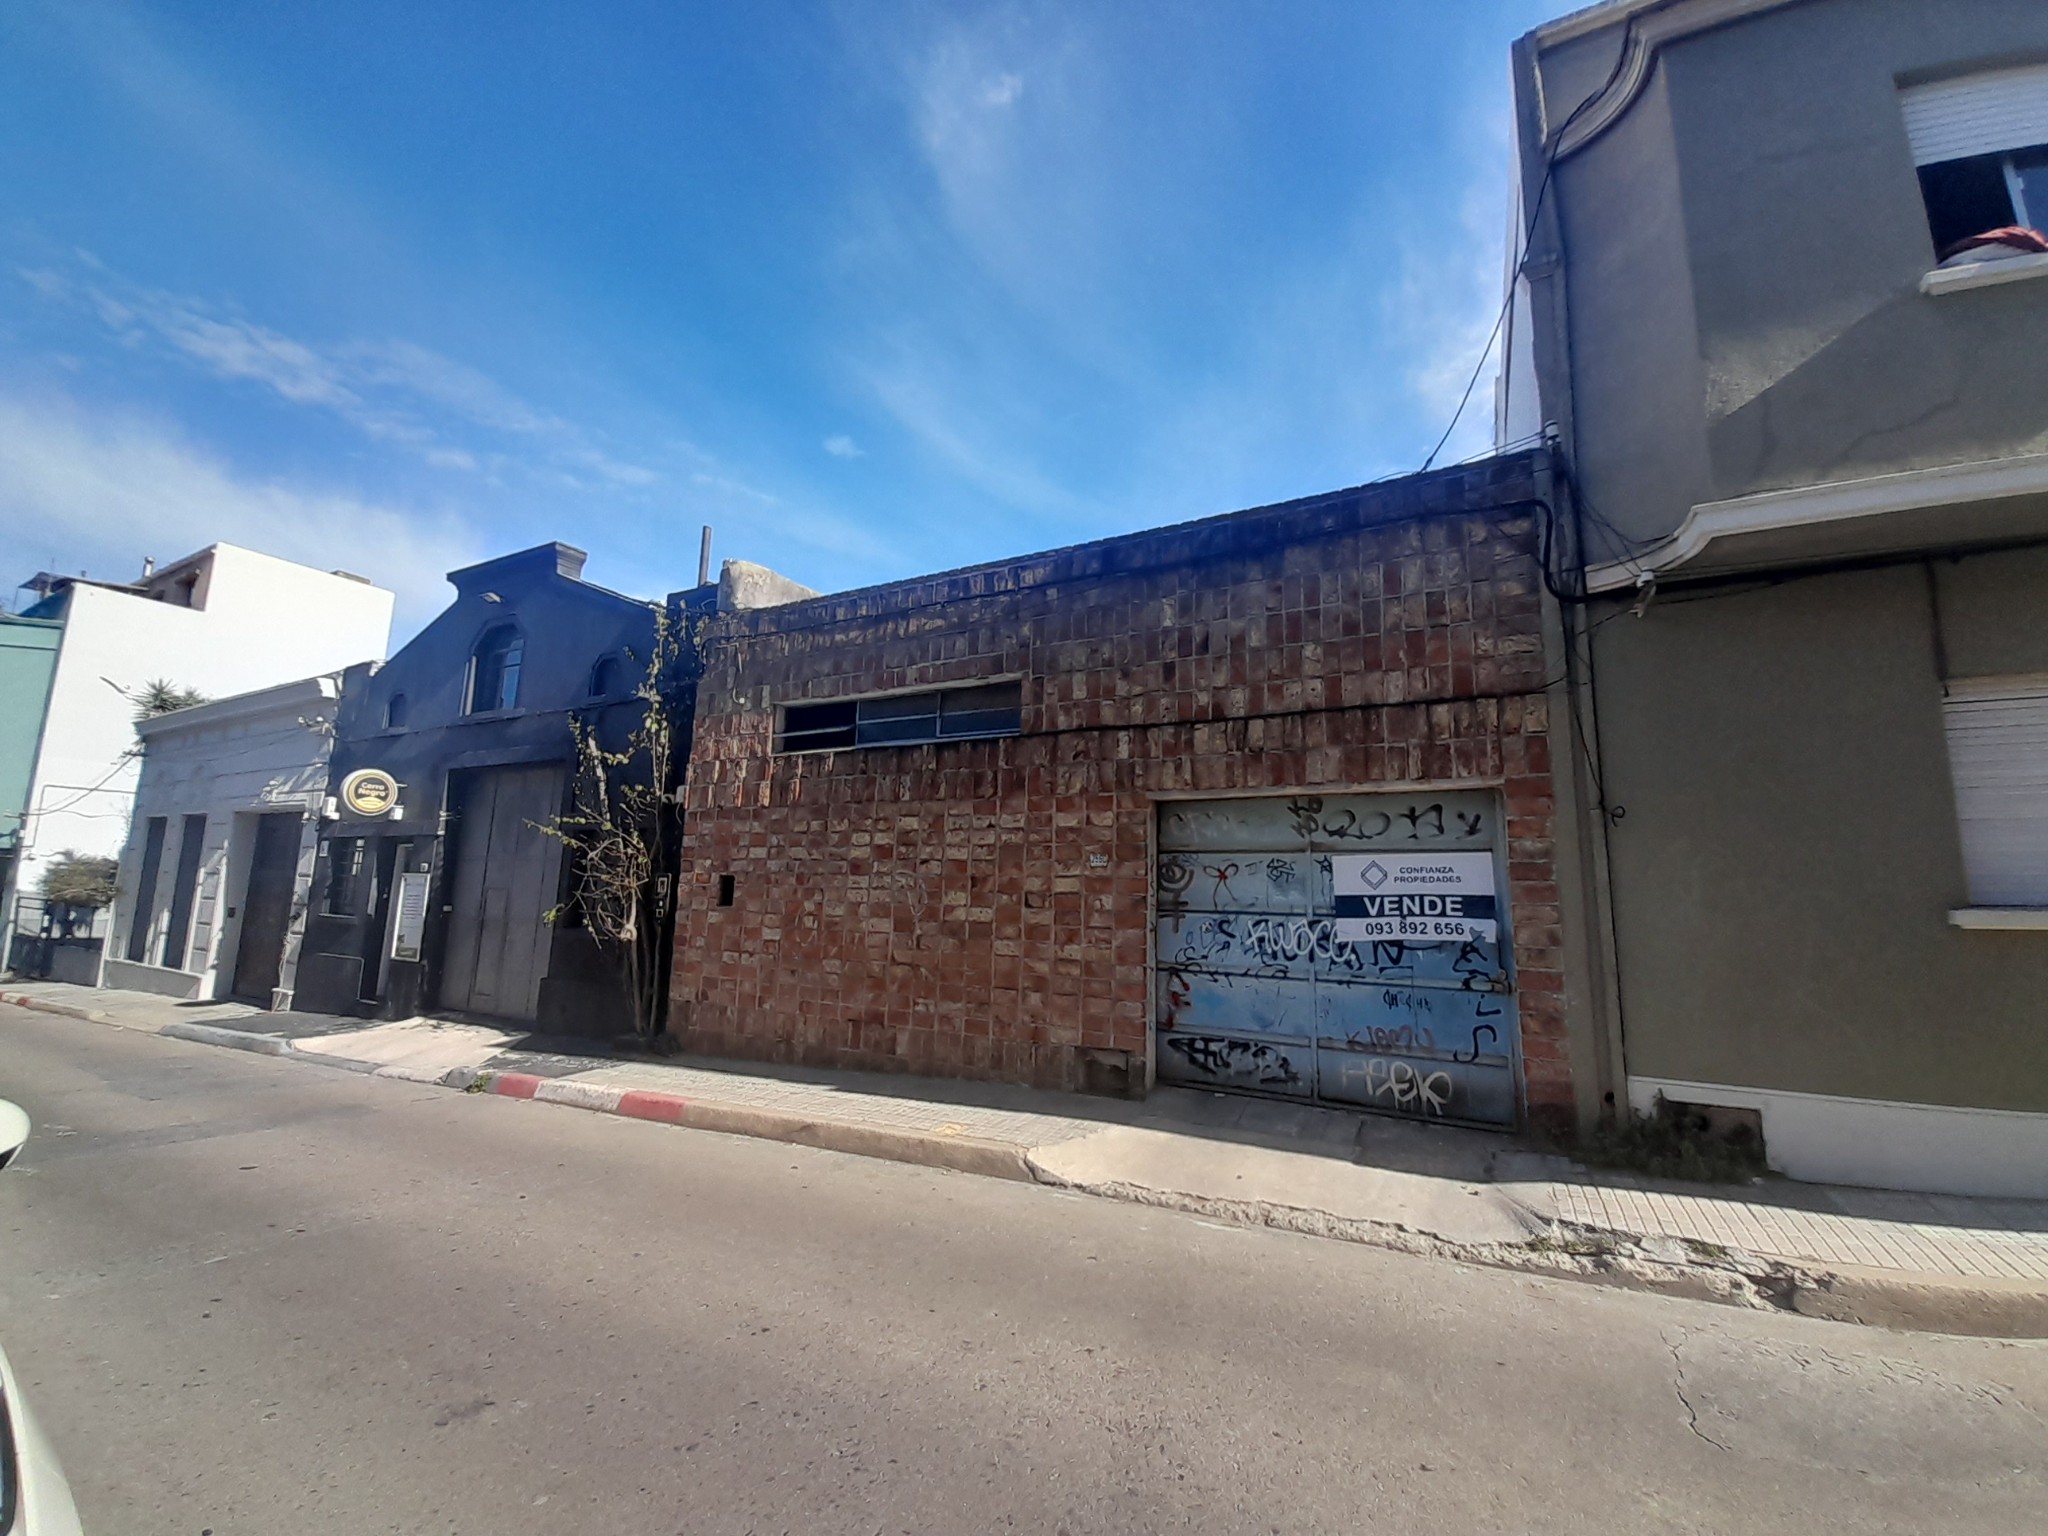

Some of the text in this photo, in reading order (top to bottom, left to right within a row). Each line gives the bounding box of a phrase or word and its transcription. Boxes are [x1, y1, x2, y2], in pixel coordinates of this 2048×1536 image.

[361, 782, 385, 790] Cerro
[358, 788, 386, 797] Negro
[1399, 866, 1454, 874] CONFIANZA
[1393, 876, 1462, 884] PROPIEDADES
[1363, 896, 1464, 917] VENDE
[1365, 922, 1465, 936] 093 892 656
